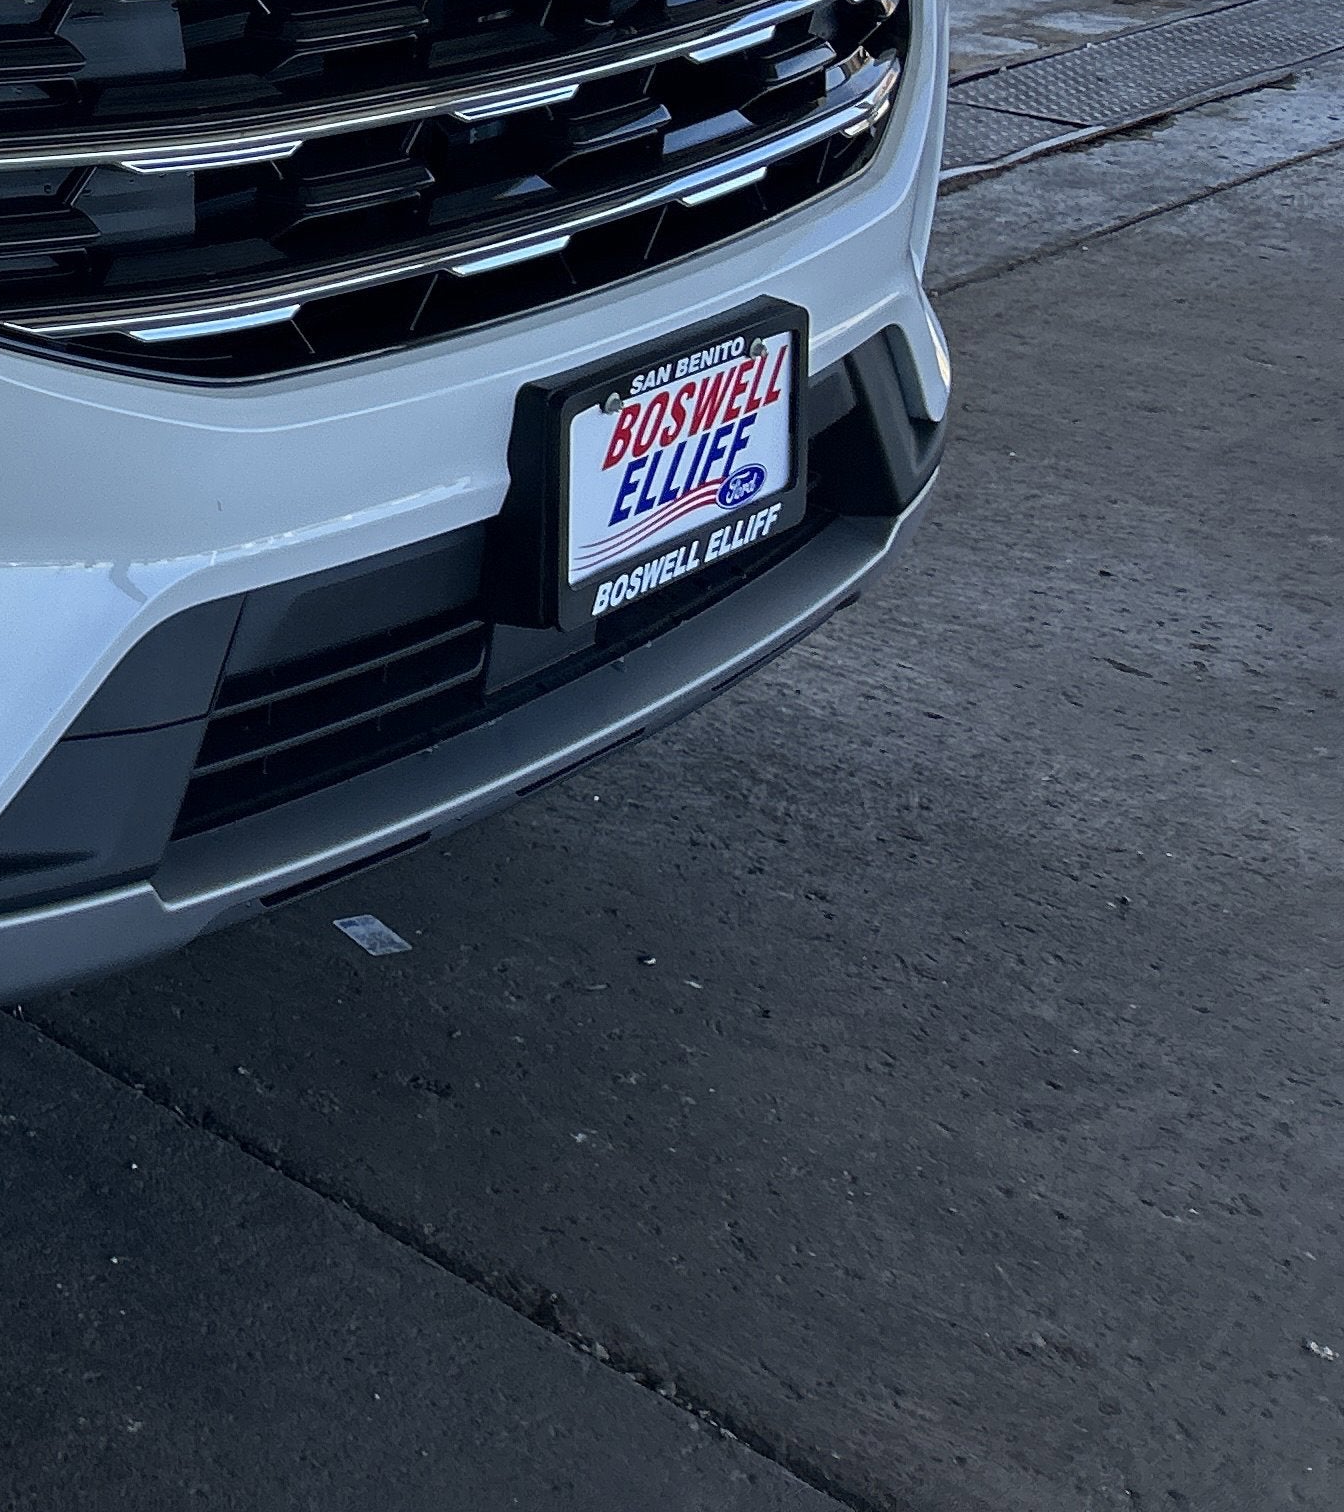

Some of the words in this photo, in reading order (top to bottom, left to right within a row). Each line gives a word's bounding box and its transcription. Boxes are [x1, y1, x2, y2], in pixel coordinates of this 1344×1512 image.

[601, 344, 789, 472] BOSWELL
[629, 364, 673, 396] SAN
[675, 335, 745, 378] BENITO
[608, 413, 758, 527] ELLIFF
[725, 470, 758, 503] Ford
[591, 539, 701, 617] BOSWELL
[704, 502, 782, 564] ELLIFF
